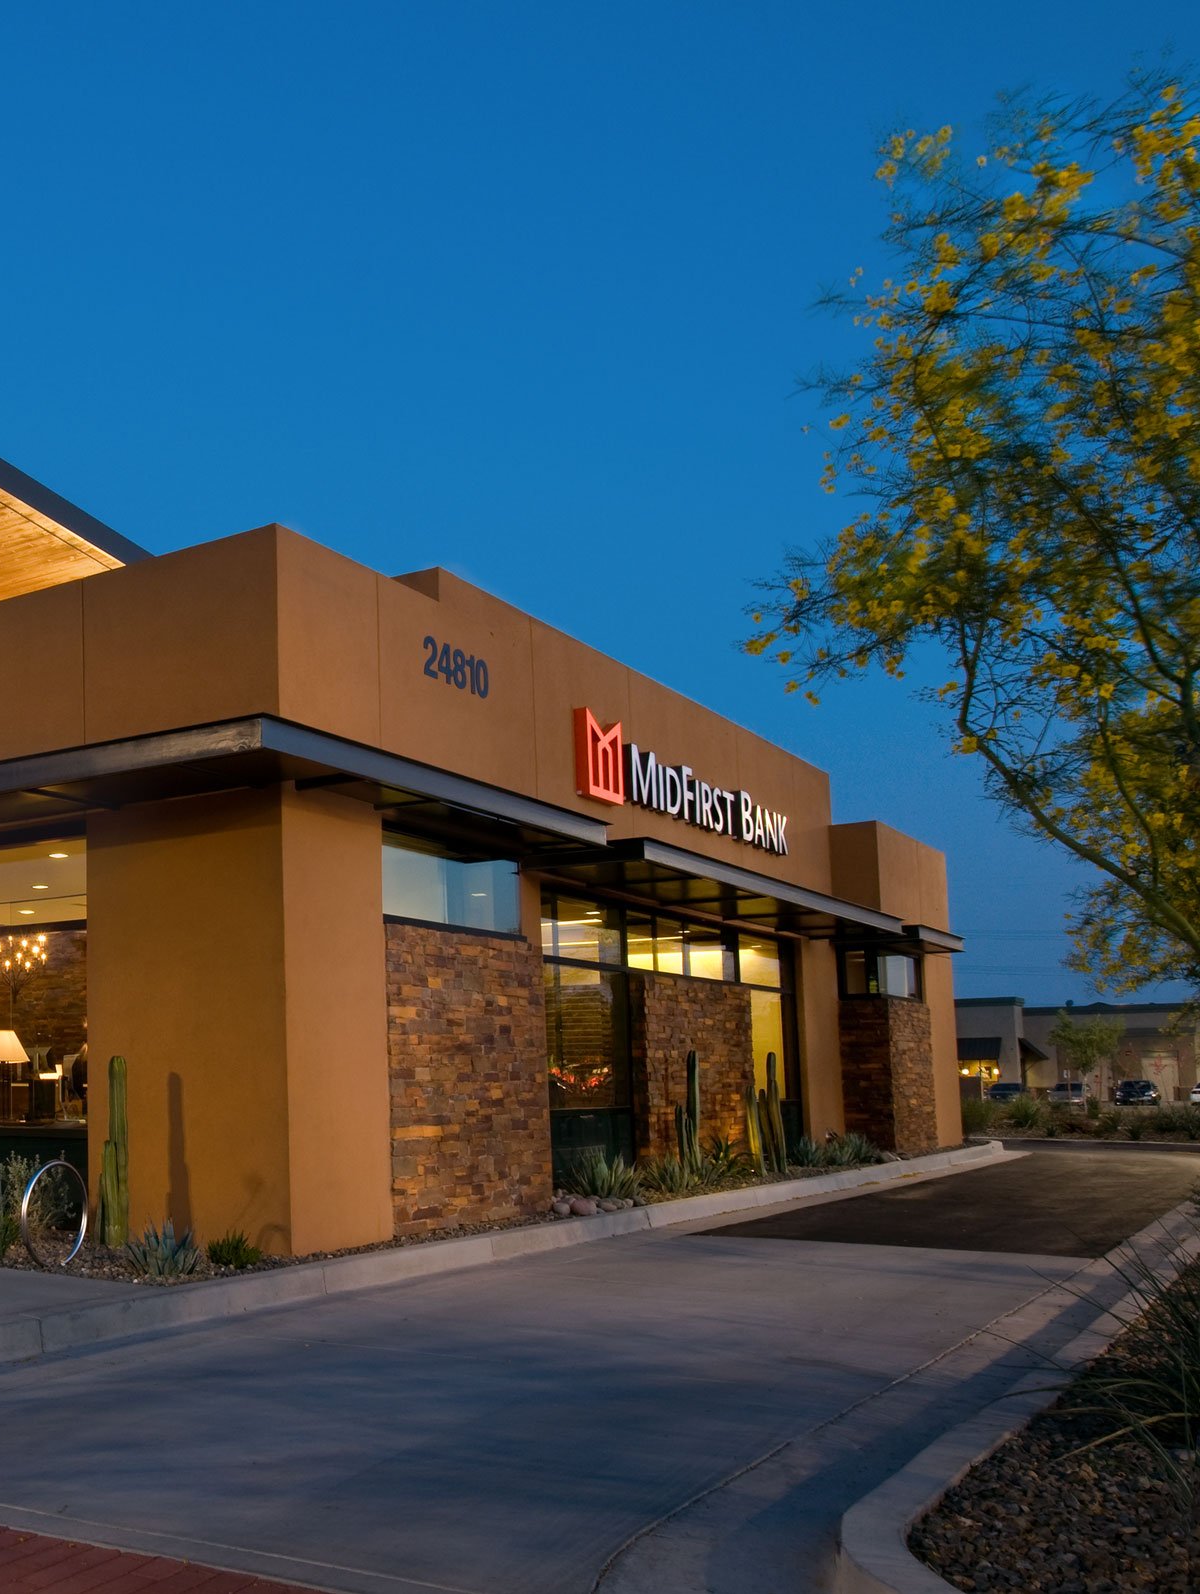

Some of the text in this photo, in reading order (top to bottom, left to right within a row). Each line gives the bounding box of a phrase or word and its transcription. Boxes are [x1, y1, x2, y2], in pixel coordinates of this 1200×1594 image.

[423, 635, 490, 699] 24810
[631, 743, 790, 857] MIDFIRST BANK
